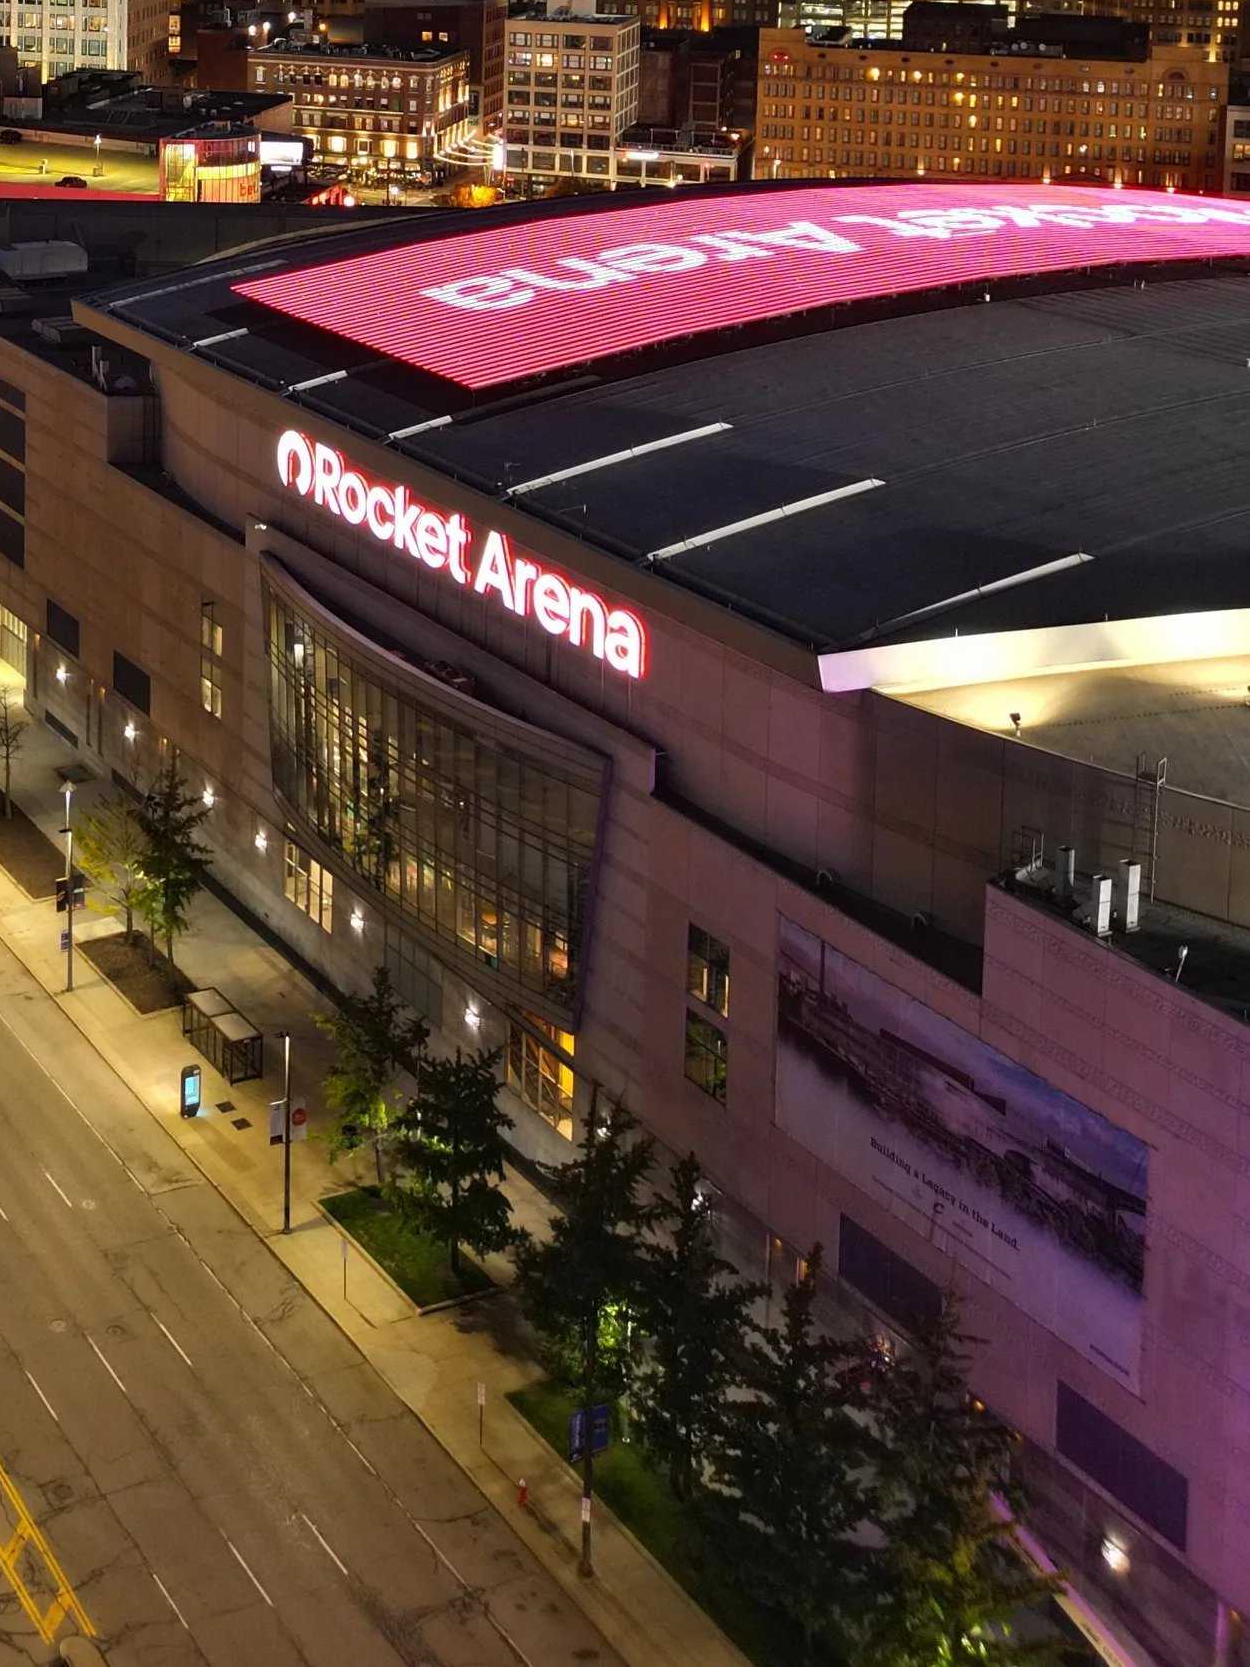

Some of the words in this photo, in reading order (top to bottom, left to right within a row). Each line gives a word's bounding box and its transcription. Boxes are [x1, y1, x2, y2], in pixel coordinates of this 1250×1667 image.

[419, 221, 865, 311] Arena
[314, 442, 472, 585] Rocket
[475, 531, 647, 679] Arena
[870, 1136, 911, 1175] Building
[921, 1173, 957, 1206] Legacy
[959, 1201, 970, 1215] in
[971, 1209, 989, 1229] the
